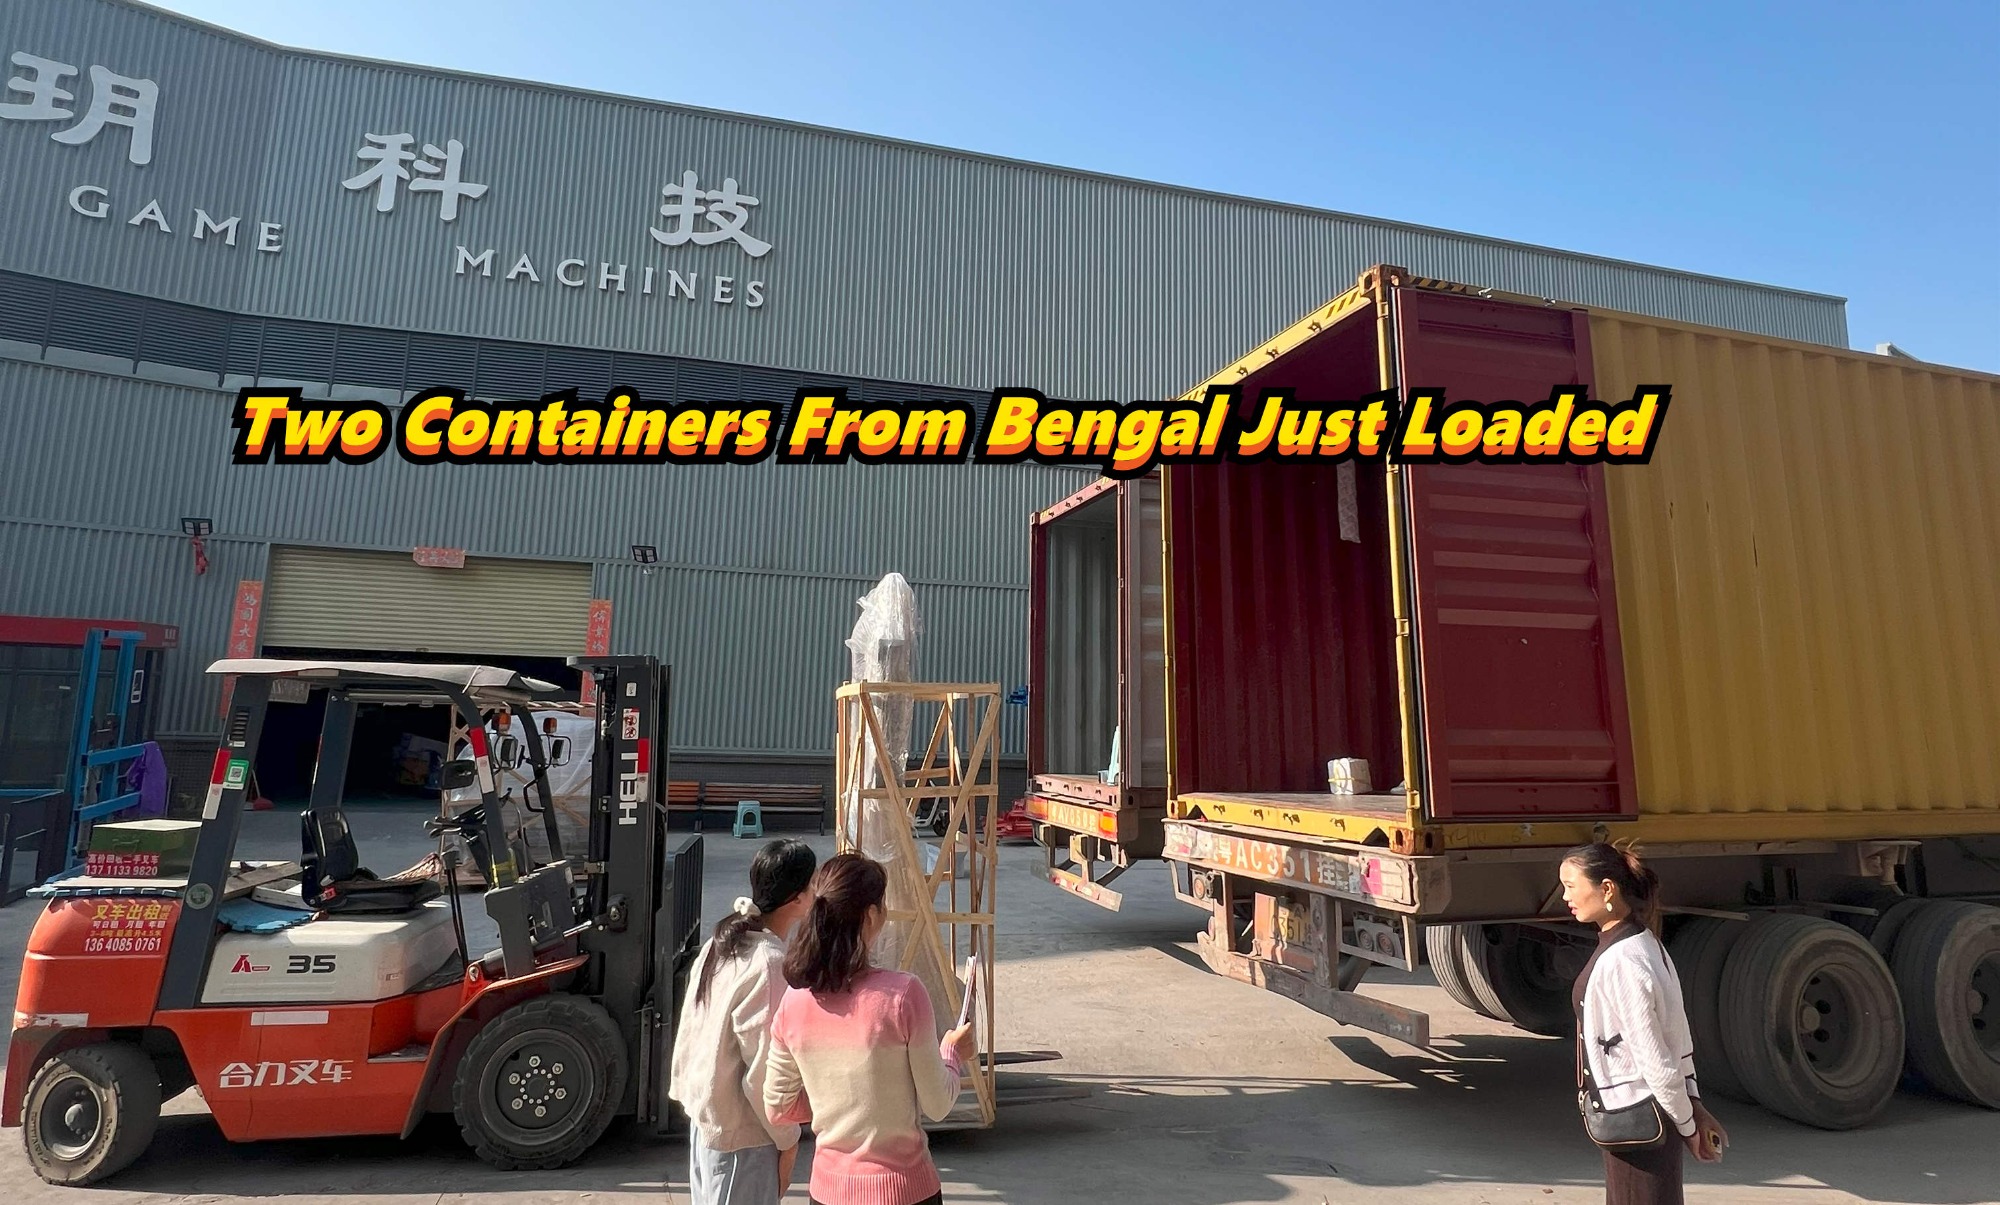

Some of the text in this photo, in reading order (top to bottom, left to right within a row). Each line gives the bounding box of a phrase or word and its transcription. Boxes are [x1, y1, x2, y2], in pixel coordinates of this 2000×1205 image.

[68, 184, 766, 308] GAME MACHINES
[618, 752, 639, 826] HELI
[86, 865, 159, 876] 137 1133 9820
[92, 904, 161, 920] 叉车出租
[85, 937, 162, 952] 136 4085 0761
[287, 954, 337, 974] 35
[219, 1058, 354, 1089] 合力叉车
